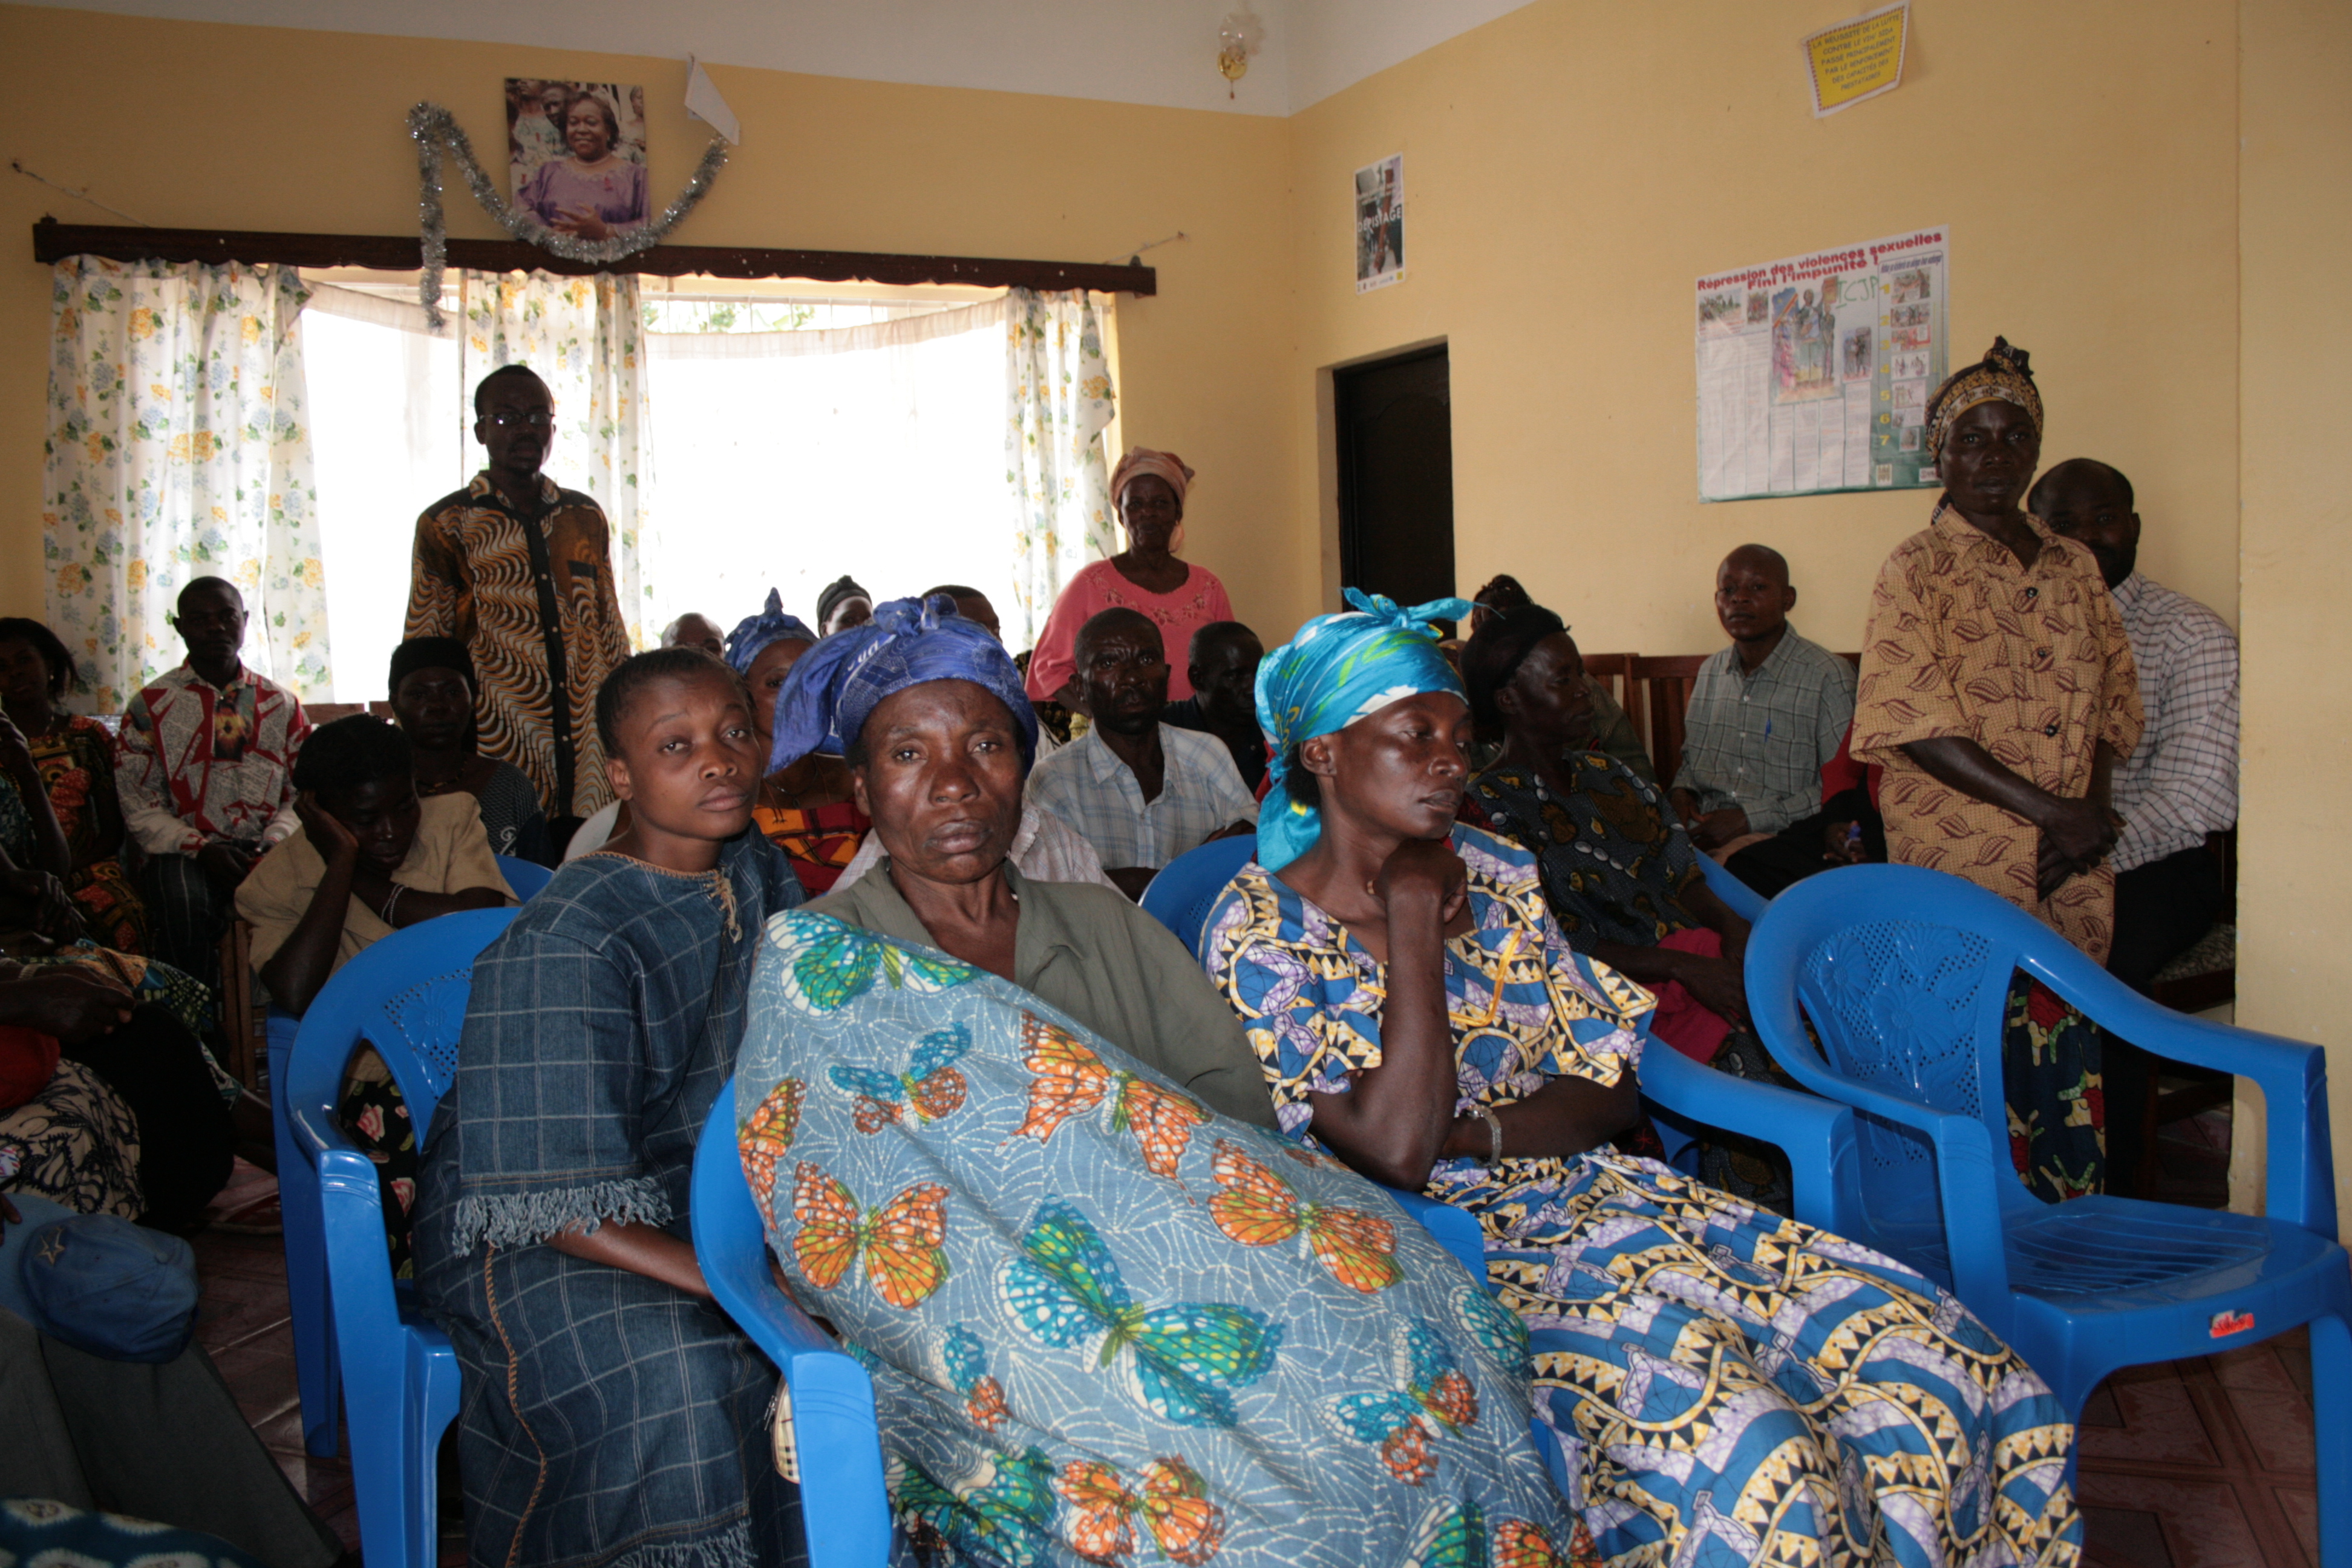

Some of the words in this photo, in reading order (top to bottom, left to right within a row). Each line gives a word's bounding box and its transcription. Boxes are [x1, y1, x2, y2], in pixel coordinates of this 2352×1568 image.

[1813, 41, 1822, 49] LA
[1863, 25, 1870, 33] DE
[1881, 14, 1900, 27] LUTTE
[1821, 53, 1844, 65] PASSE
[1847, 36, 1896, 58] PRINCIPALEMENT
[1823, 41, 1852, 55] CONTRE
[1854, 38, 1861, 47] LE
[1878, 28, 1893, 38] SIDA
[1825, 65, 1838, 74] PAR
[1850, 47, 1894, 68] RENFORCEMENT
[1832, 74, 1844, 83] DES
[1879, 58, 1889, 68] DES
[1841, 71, 1881, 90] PRESTATAIRES
[1771, 262, 1794, 276] des
[1798, 249, 1865, 273] violences
[1869, 231, 1942, 257] sexuelles
[1748, 273, 1777, 290] Fini
[1880, 315, 1890, 327] 2
[1880, 340, 1890, 350] 3
[1880, 364, 1890, 375] 4
[1880, 390, 1890, 402] 5
[1880, 414, 1890, 424] 6
[1880, 436, 1889, 446] 7
